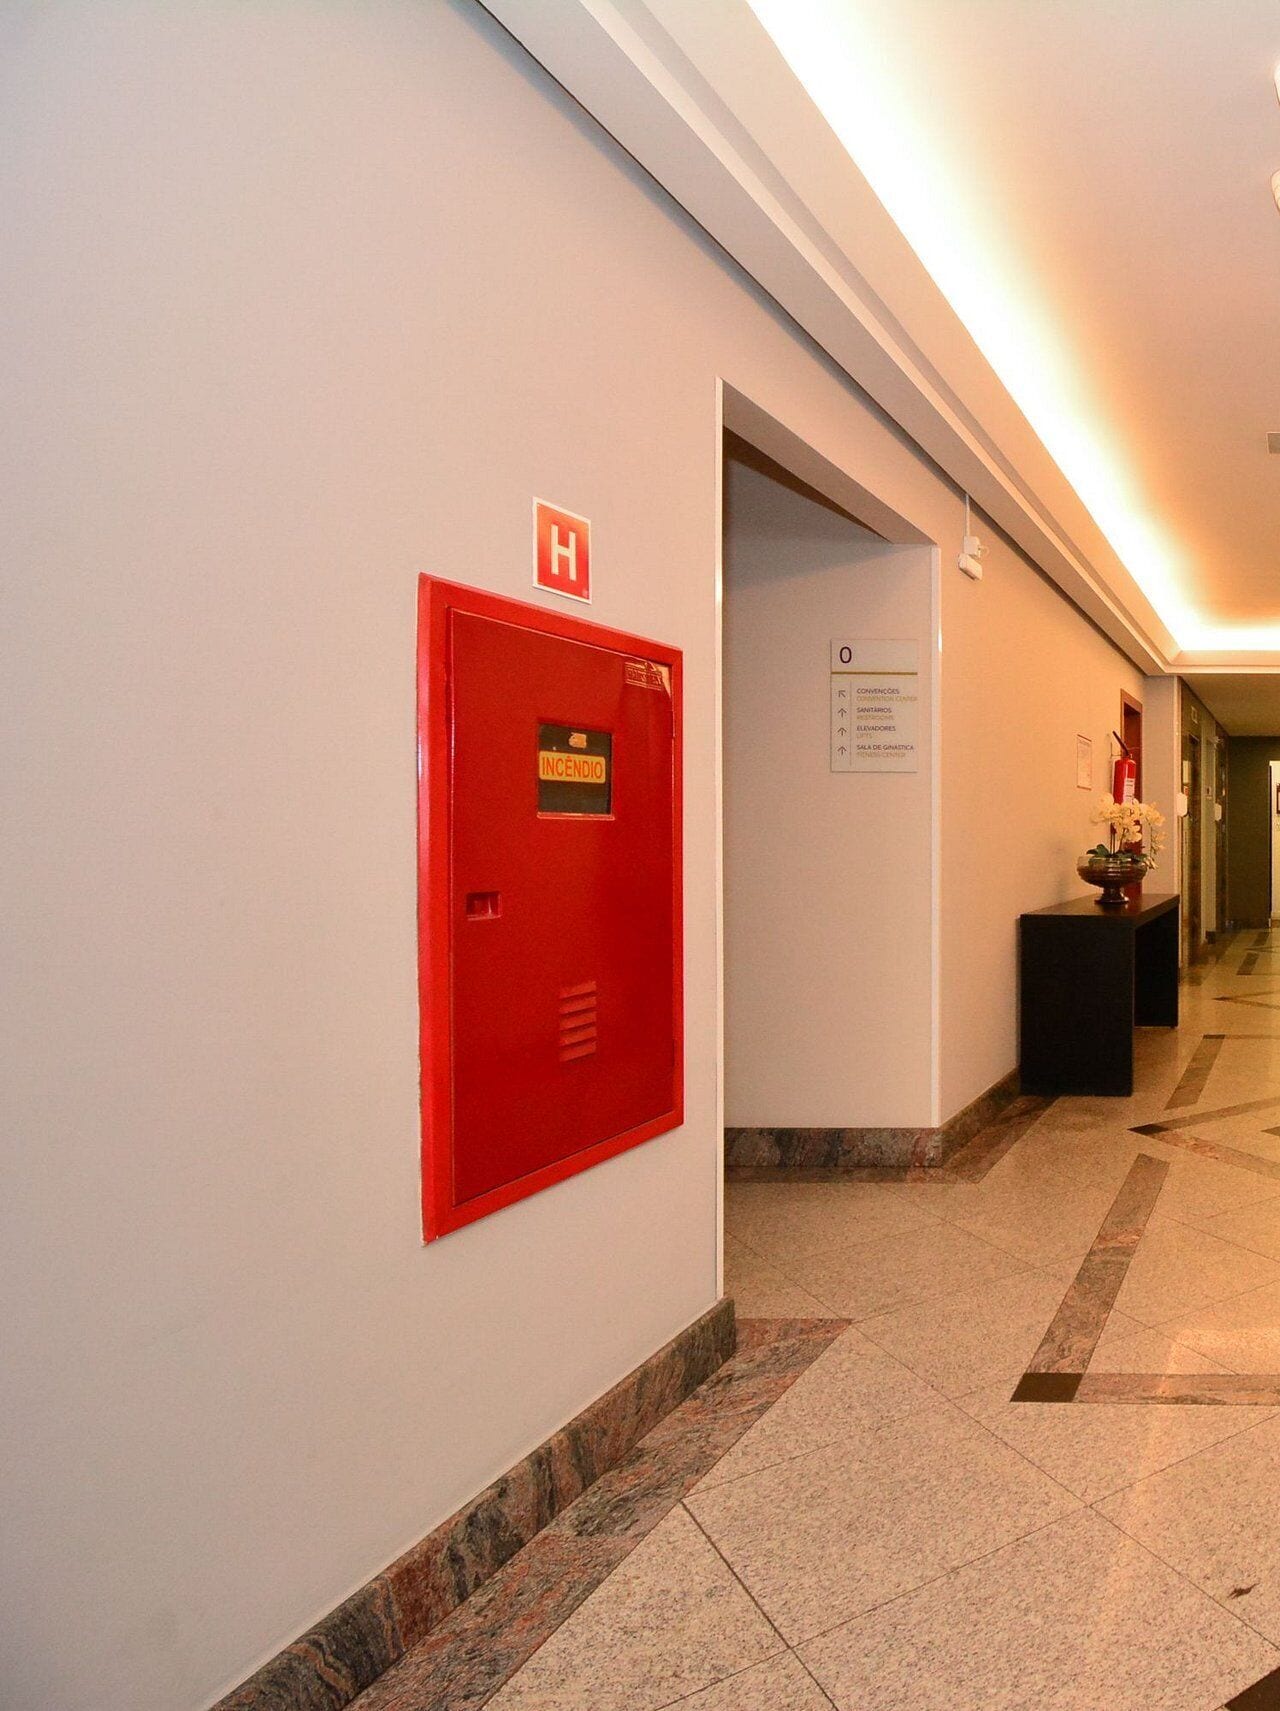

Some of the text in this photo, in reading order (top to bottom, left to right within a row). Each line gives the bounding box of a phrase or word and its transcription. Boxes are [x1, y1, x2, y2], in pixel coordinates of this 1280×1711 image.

[550, 523, 577, 582] H
[839, 646, 852, 664] 0
[856, 687, 900, 695] CONVENÇÕES
[542, 755, 604, 779] INCÊNDIO
